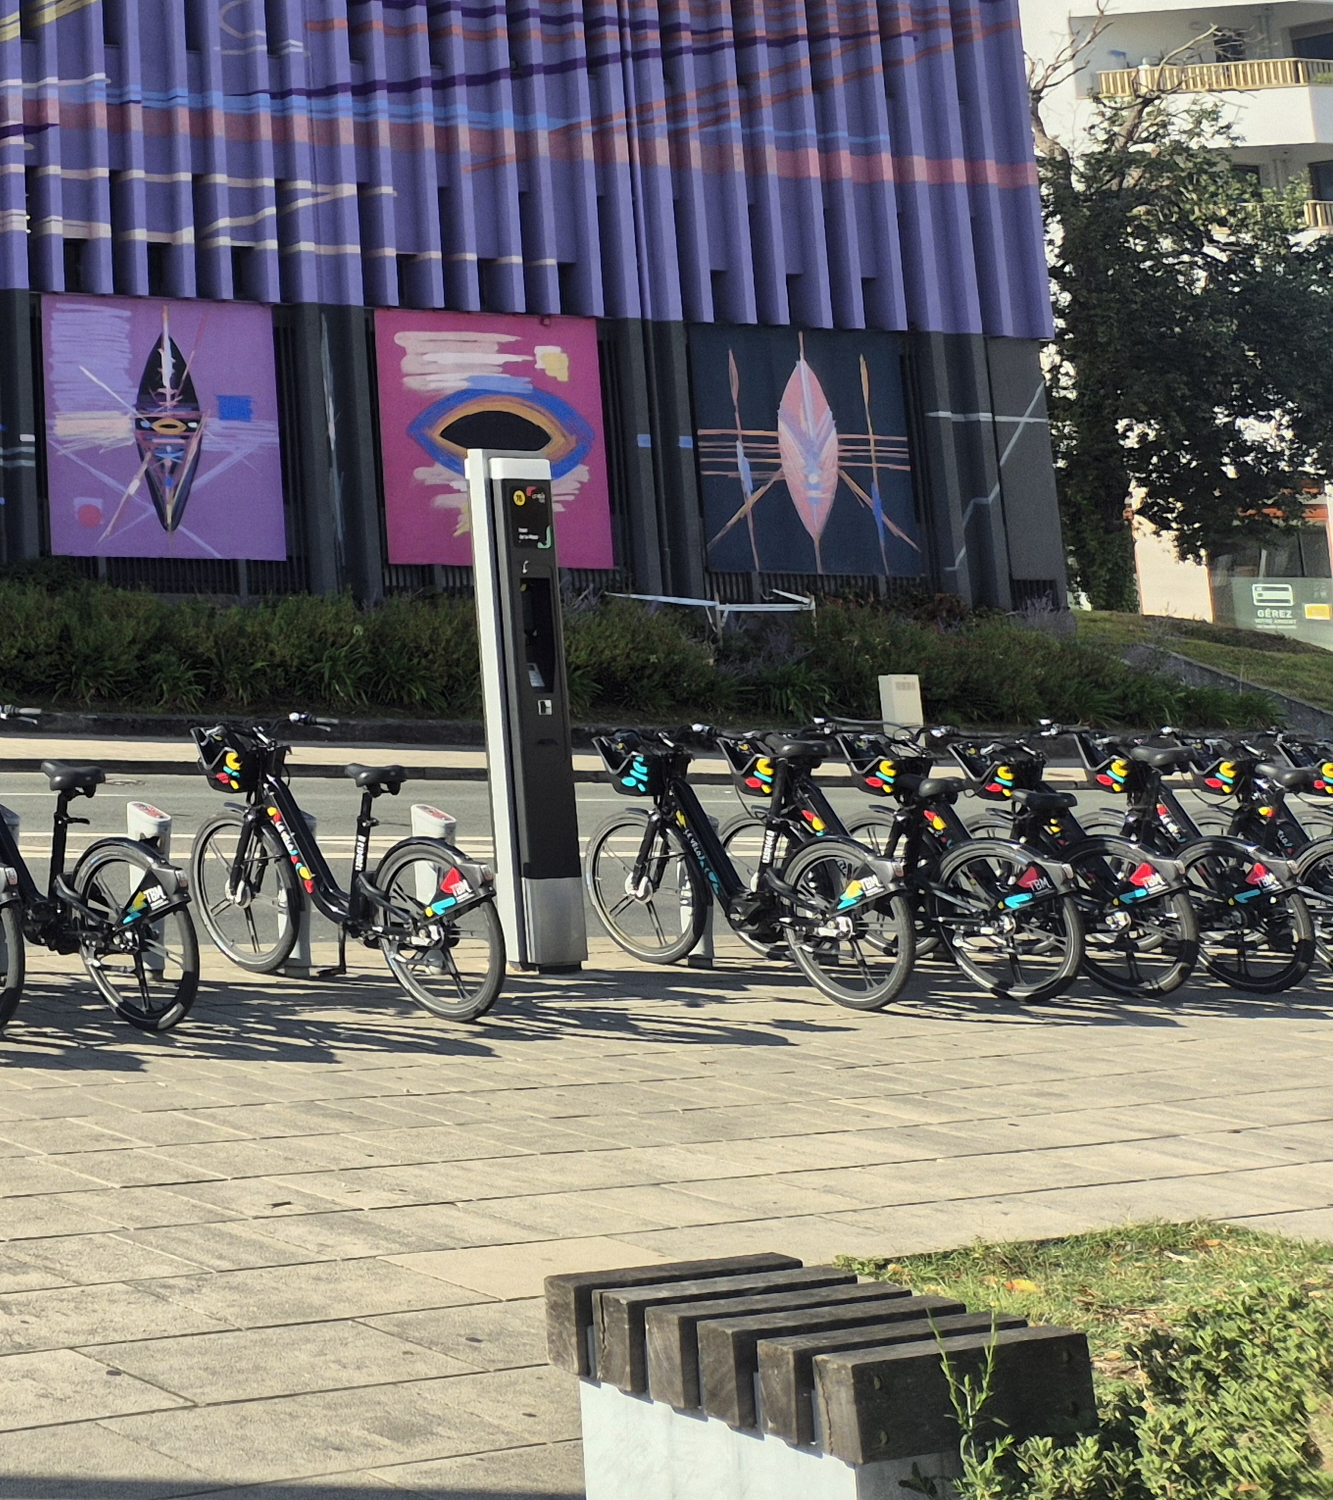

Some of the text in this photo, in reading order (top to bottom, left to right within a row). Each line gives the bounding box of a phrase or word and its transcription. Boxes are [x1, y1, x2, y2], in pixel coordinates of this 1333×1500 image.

[1257, 608, 1292, 618] GÉREZ
[449, 879, 473, 896] TBM
[860, 874, 883, 892] TBM
[1026, 876, 1052, 891] TBM
[144, 884, 167, 905] TBM
